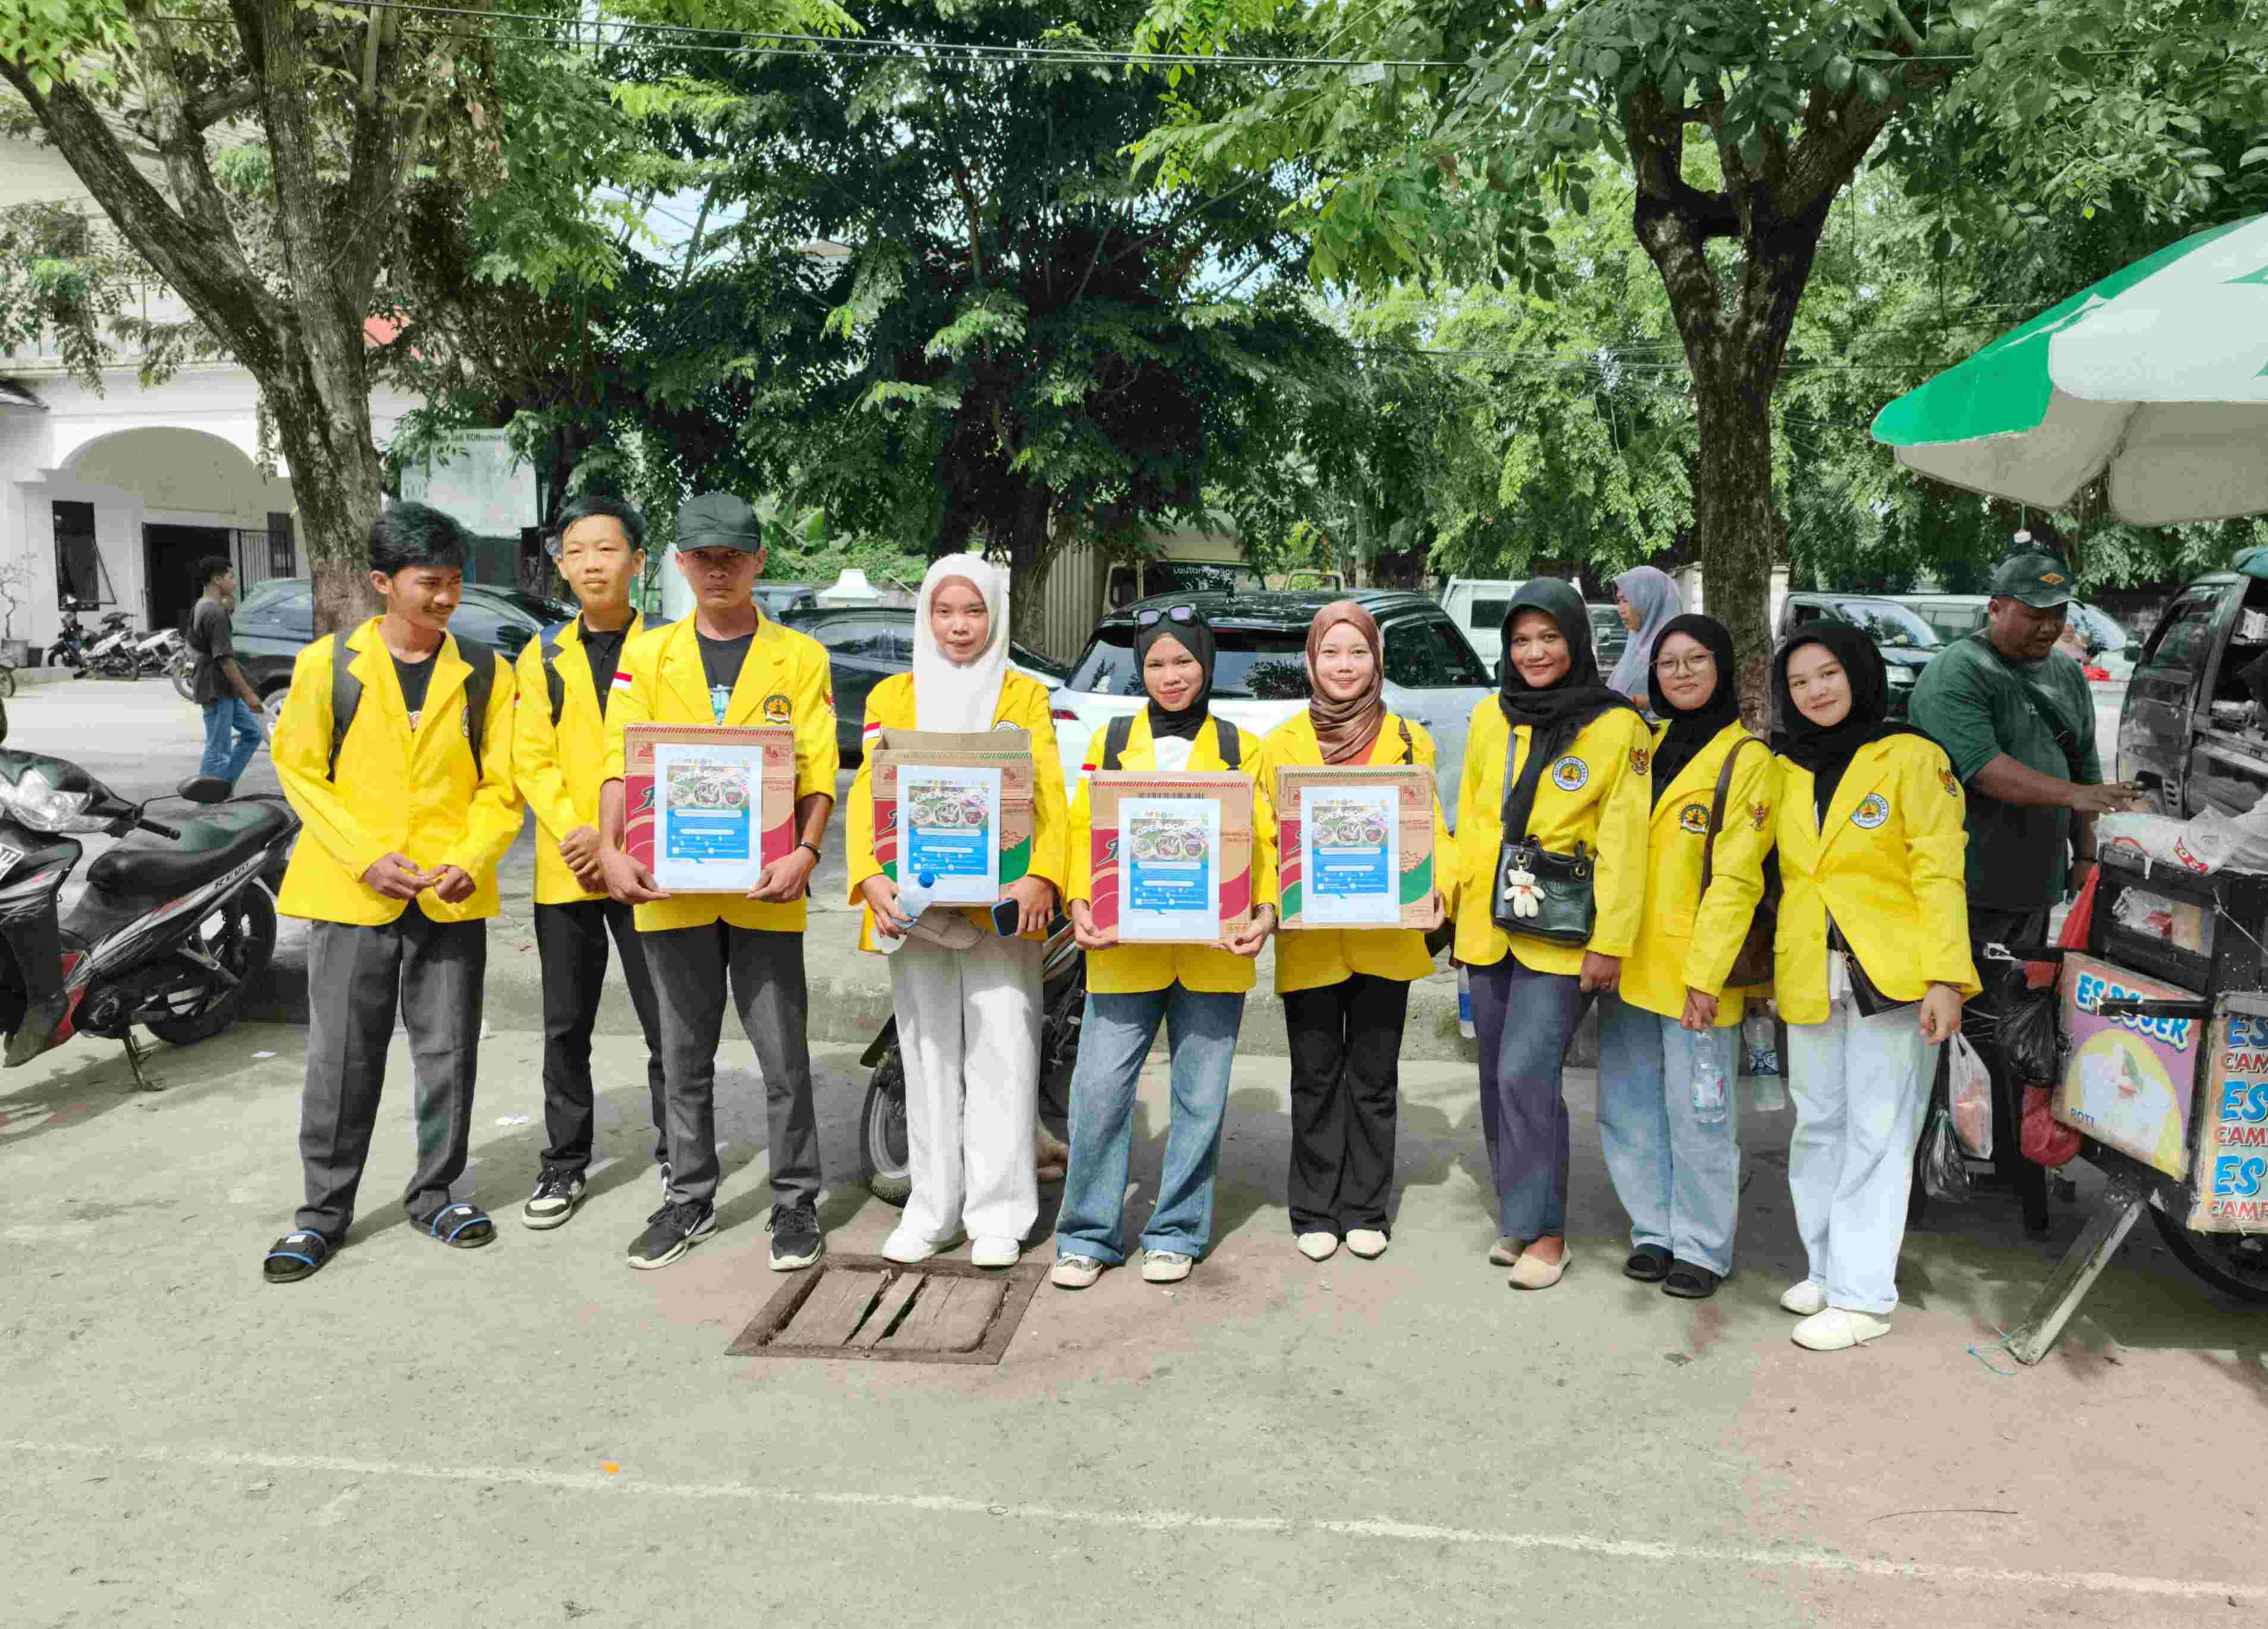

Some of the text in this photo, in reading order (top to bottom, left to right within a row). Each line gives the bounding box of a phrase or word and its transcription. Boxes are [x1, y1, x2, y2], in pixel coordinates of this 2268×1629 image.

[2076, 972, 2106, 1011] ES
[2221, 1080, 2268, 1122] ES
[2212, 1155, 2267, 1197] ES
